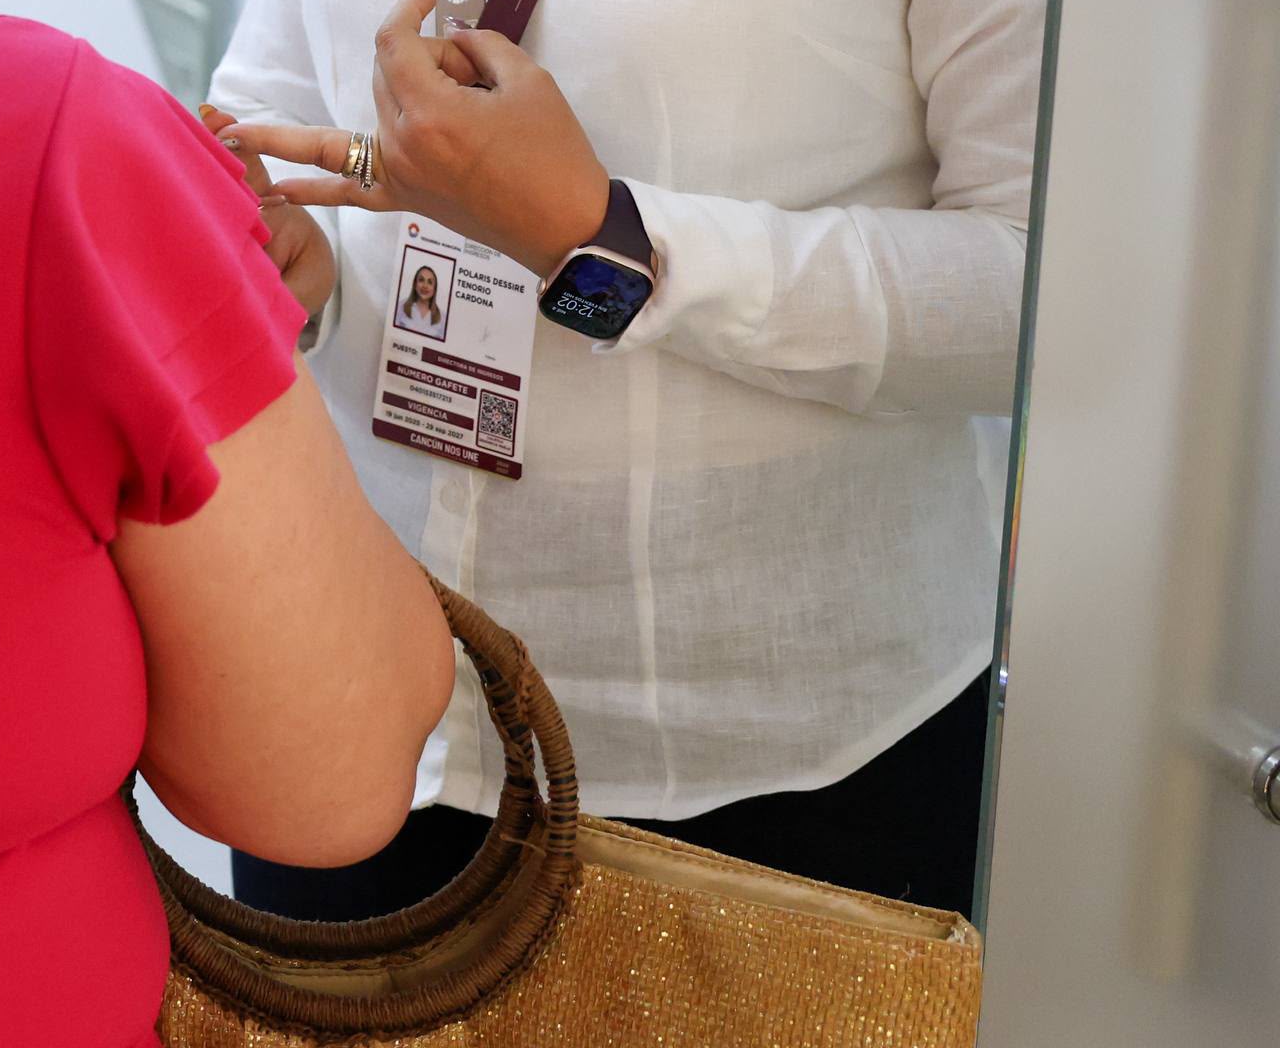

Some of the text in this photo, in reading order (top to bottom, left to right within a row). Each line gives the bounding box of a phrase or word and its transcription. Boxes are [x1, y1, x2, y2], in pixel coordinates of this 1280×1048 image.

[458, 267, 491, 284] POLARIS
[457, 279, 491, 296] TENORIO
[455, 290, 494, 308] CARDONA
[557, 295, 594, 318] 12:02
[434, 375, 469, 394] GAFETE
[407, 401, 448, 421] VIGENCIA
[444, 443, 461, 457] NOS
[462, 449, 480, 463] UNE
